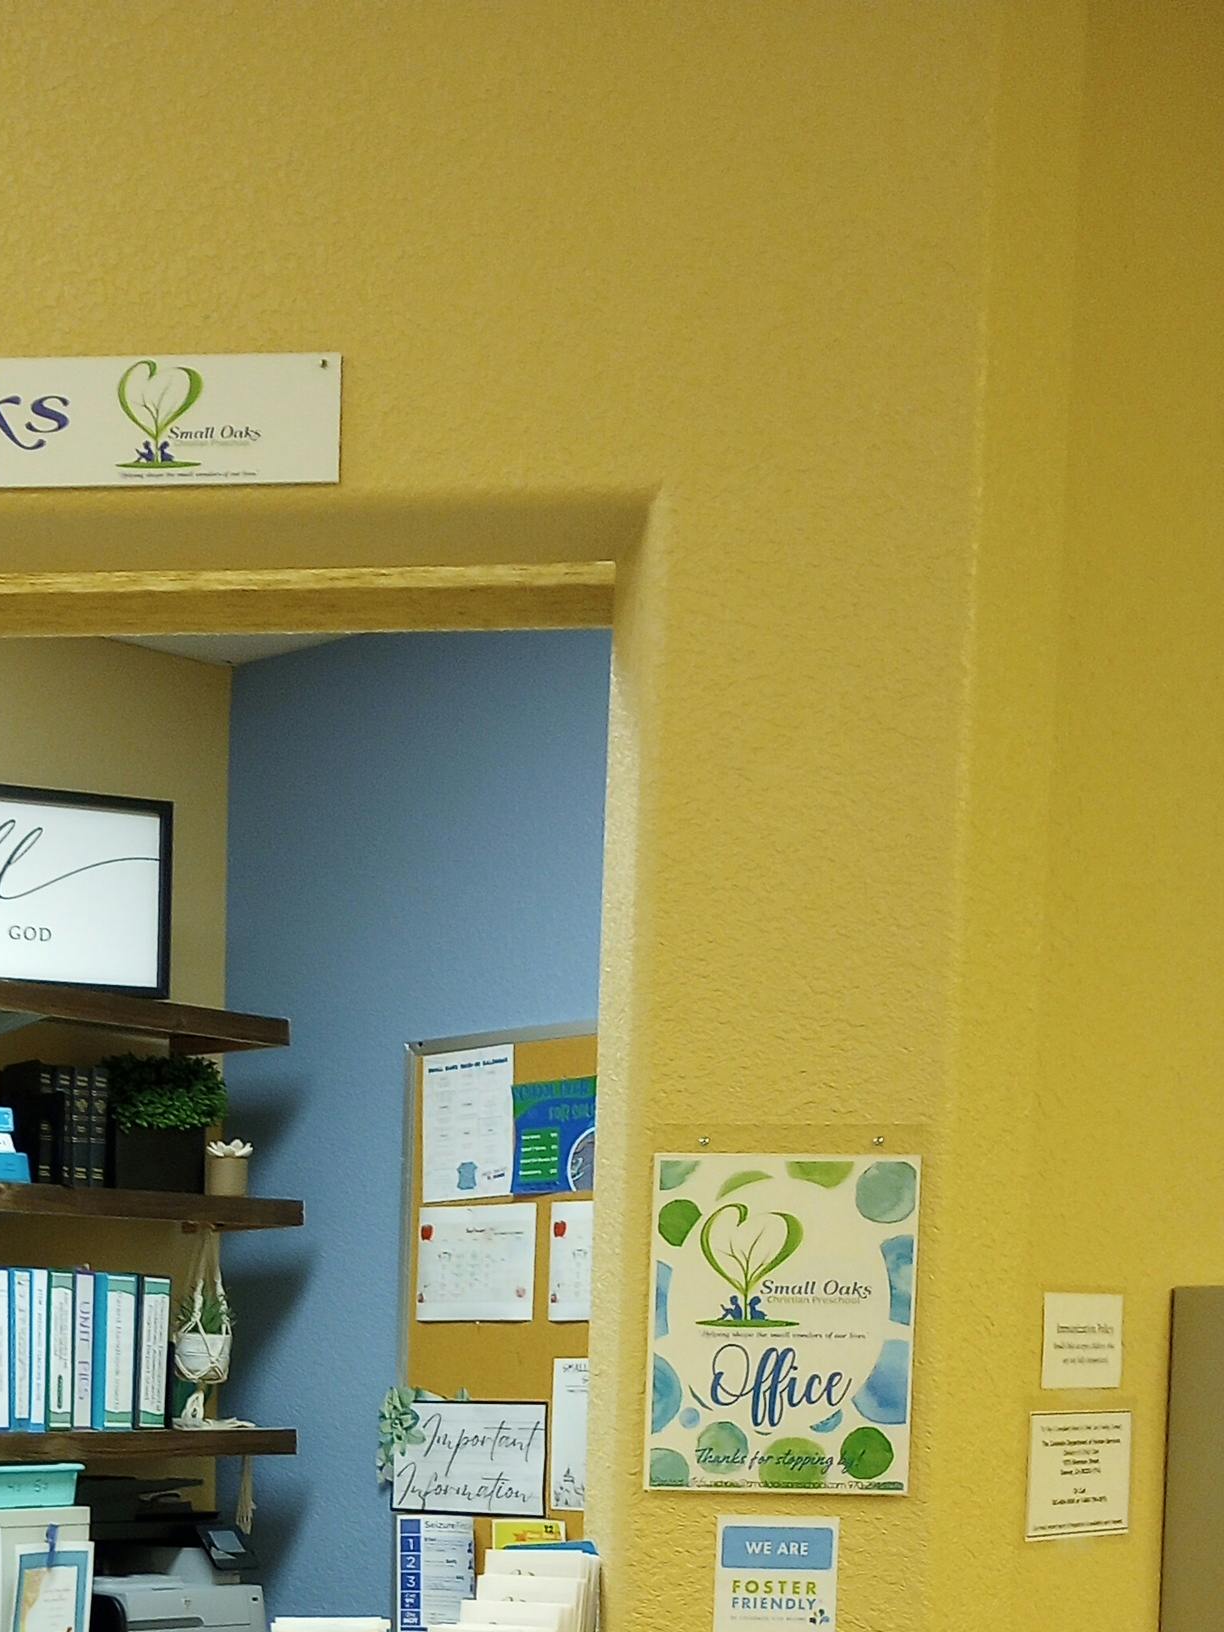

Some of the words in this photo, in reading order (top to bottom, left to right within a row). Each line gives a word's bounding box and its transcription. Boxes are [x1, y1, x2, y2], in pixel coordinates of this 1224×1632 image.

[168, 425, 214, 440] Small
[220, 424, 262, 441] Oaks
[8, 924, 53, 943] GOD
[760, 1279, 816, 1296] Small
[823, 1279, 872, 1299] Oaks
[710, 1343, 853, 1428] Office
[423, 1413, 545, 1476] Important
[695, 1448, 746, 1465] Thanks
[748, 1450, 776, 1470] for
[775, 1449, 834, 1474] stopping
[837, 1450, 866, 1473] by!
[396, 1462, 531, 1510] Information
[424, 1520, 455, 1529] Seizure
[407, 1538, 414, 1550] 1
[745, 1541, 773, 1555] WE
[776, 1541, 809, 1556] ARE
[406, 1556, 416, 1568] 2
[406, 1575, 416, 1587] 3
[732, 1580, 817, 1595] FOSTER
[731, 1597, 817, 1610] FRIENDLY
